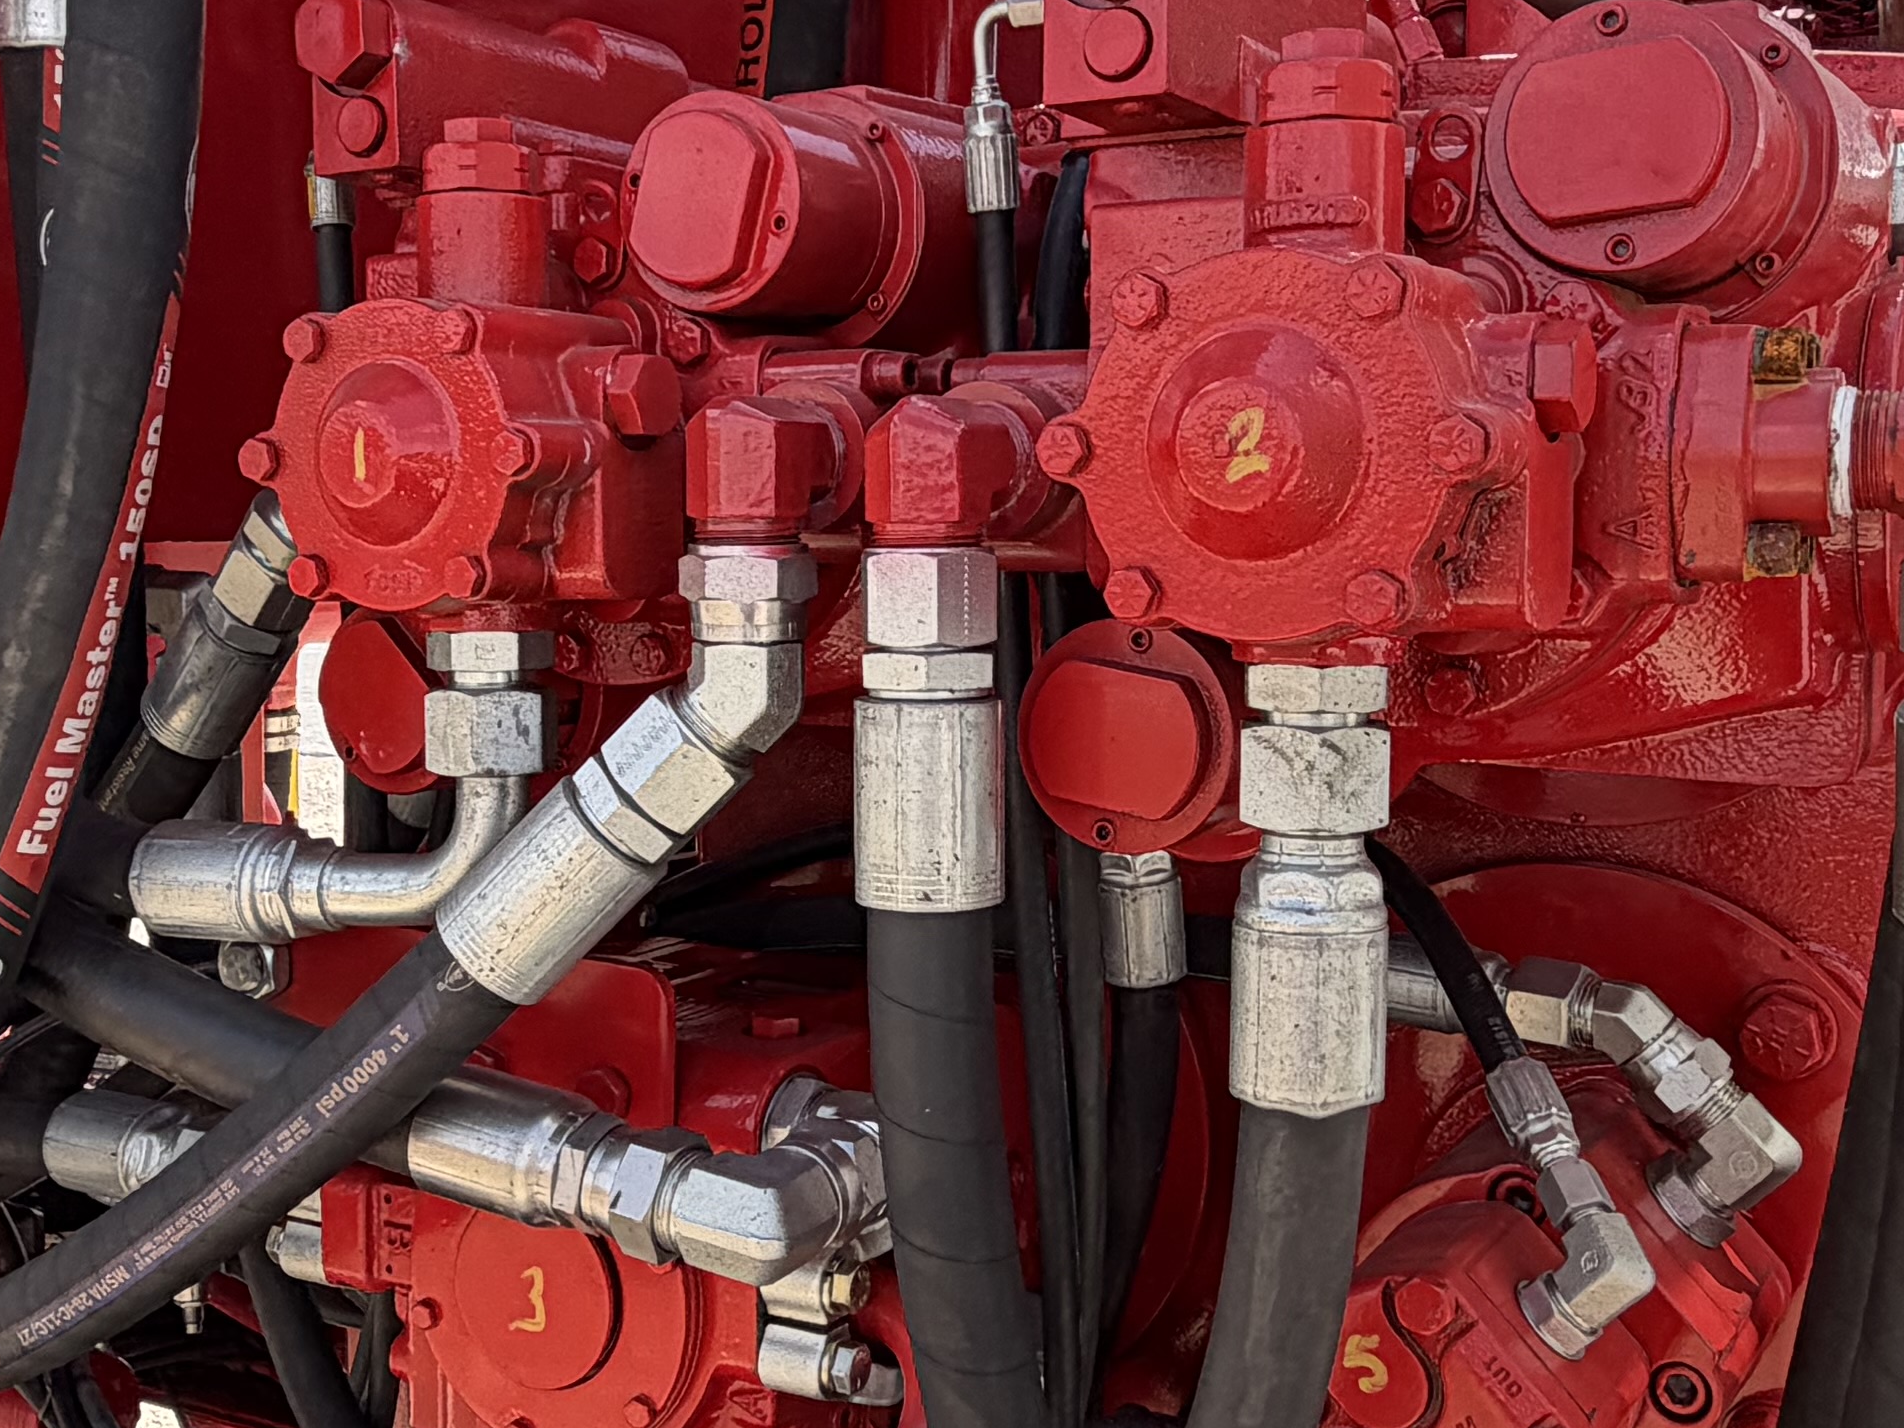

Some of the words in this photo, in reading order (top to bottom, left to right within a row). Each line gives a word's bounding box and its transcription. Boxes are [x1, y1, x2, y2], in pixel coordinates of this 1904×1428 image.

[1224, 405, 1271, 483] 2
[15, 766, 75, 856] Fuel
[88, 1264, 132, 1300] MSHA
[507, 1265, 546, 1333] 3
[1342, 1333, 1389, 1394] 5
[1481, 1355, 1523, 1399] OUT
